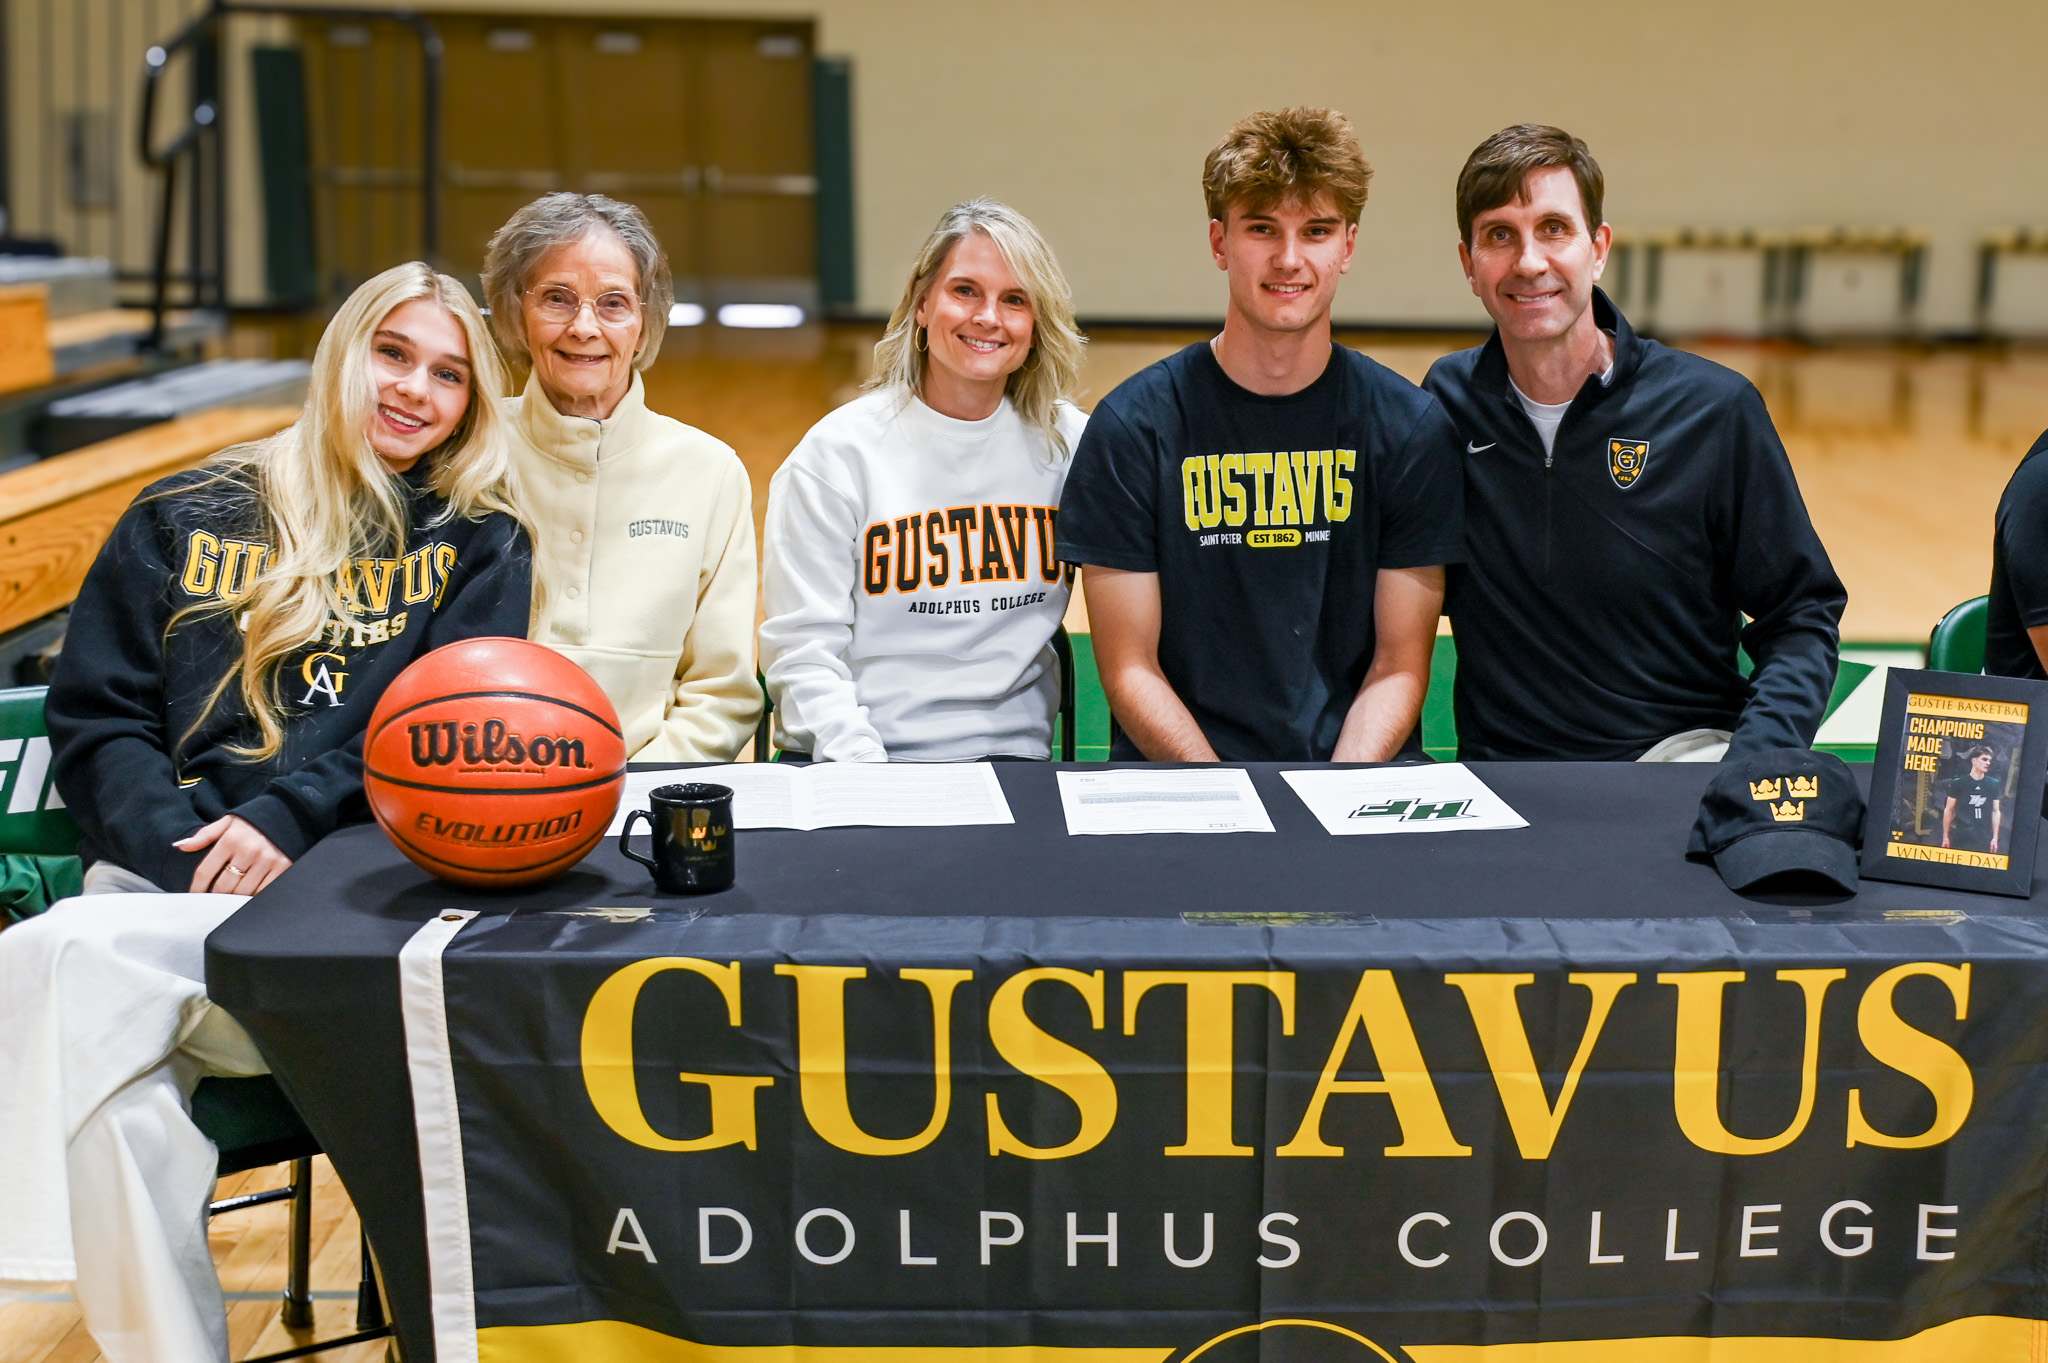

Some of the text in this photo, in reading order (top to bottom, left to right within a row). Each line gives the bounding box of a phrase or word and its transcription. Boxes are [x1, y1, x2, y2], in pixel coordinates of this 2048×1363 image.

[629, 520, 688, 538] GUSTAVUS
[1200, 534, 1220, 546] SAINT
[1221, 533, 1242, 544] PETER
[1253, 534, 1270, 543] EST
[1273, 533, 1294, 543] 1862
[864, 504, 1075, 596] GUSTAVU
[181, 529, 457, 612] GUAVUS
[908, 592, 1046, 615] ADOLPHUS COLLEGE
[1908, 696, 1953, 711] GUSTIE
[1910, 717, 1984, 740] CHAMPIONS
[408, 718, 587, 770] Wilson
[1907, 735, 1943, 755] MADE
[1904, 754, 1938, 773] HERE
[415, 809, 583, 843] EVOLUTION
[1896, 846, 2002, 868] WIN THE DAY
[580, 957, 1975, 1160] GUSTAVUS
[607, 1200, 1959, 1269] ADOLPHUS COLLEGE
